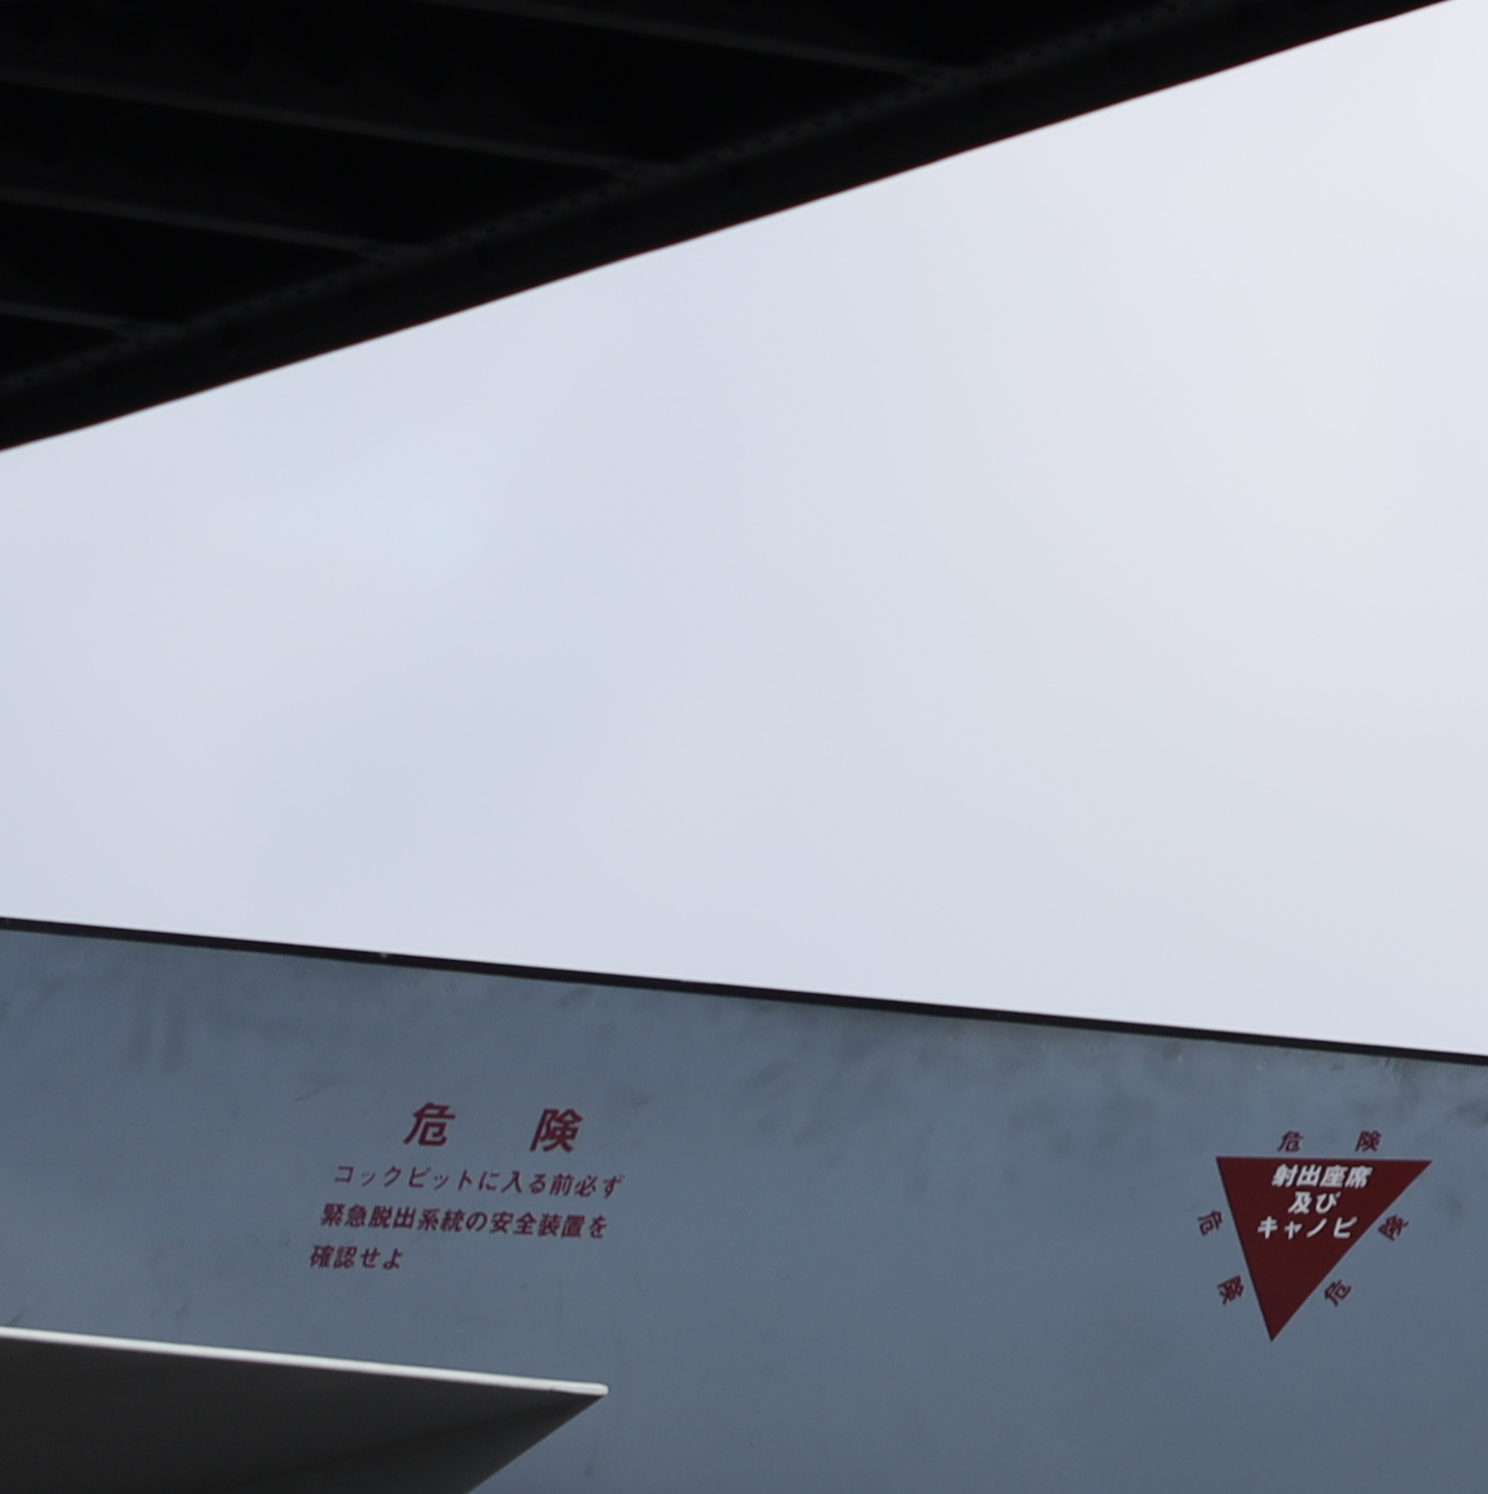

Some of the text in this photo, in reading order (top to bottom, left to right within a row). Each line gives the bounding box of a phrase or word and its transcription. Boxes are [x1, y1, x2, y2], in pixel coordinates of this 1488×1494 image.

[334, 1164, 626, 1199] コックピットに入る前必ず
[1271, 1164, 1373, 1189] 射出座席
[1288, 1191, 1342, 1214] 及び
[320, 1203, 608, 1239] 緊急脱出系統の安全装置を
[309, 1244, 404, 1270] 確認せよ
